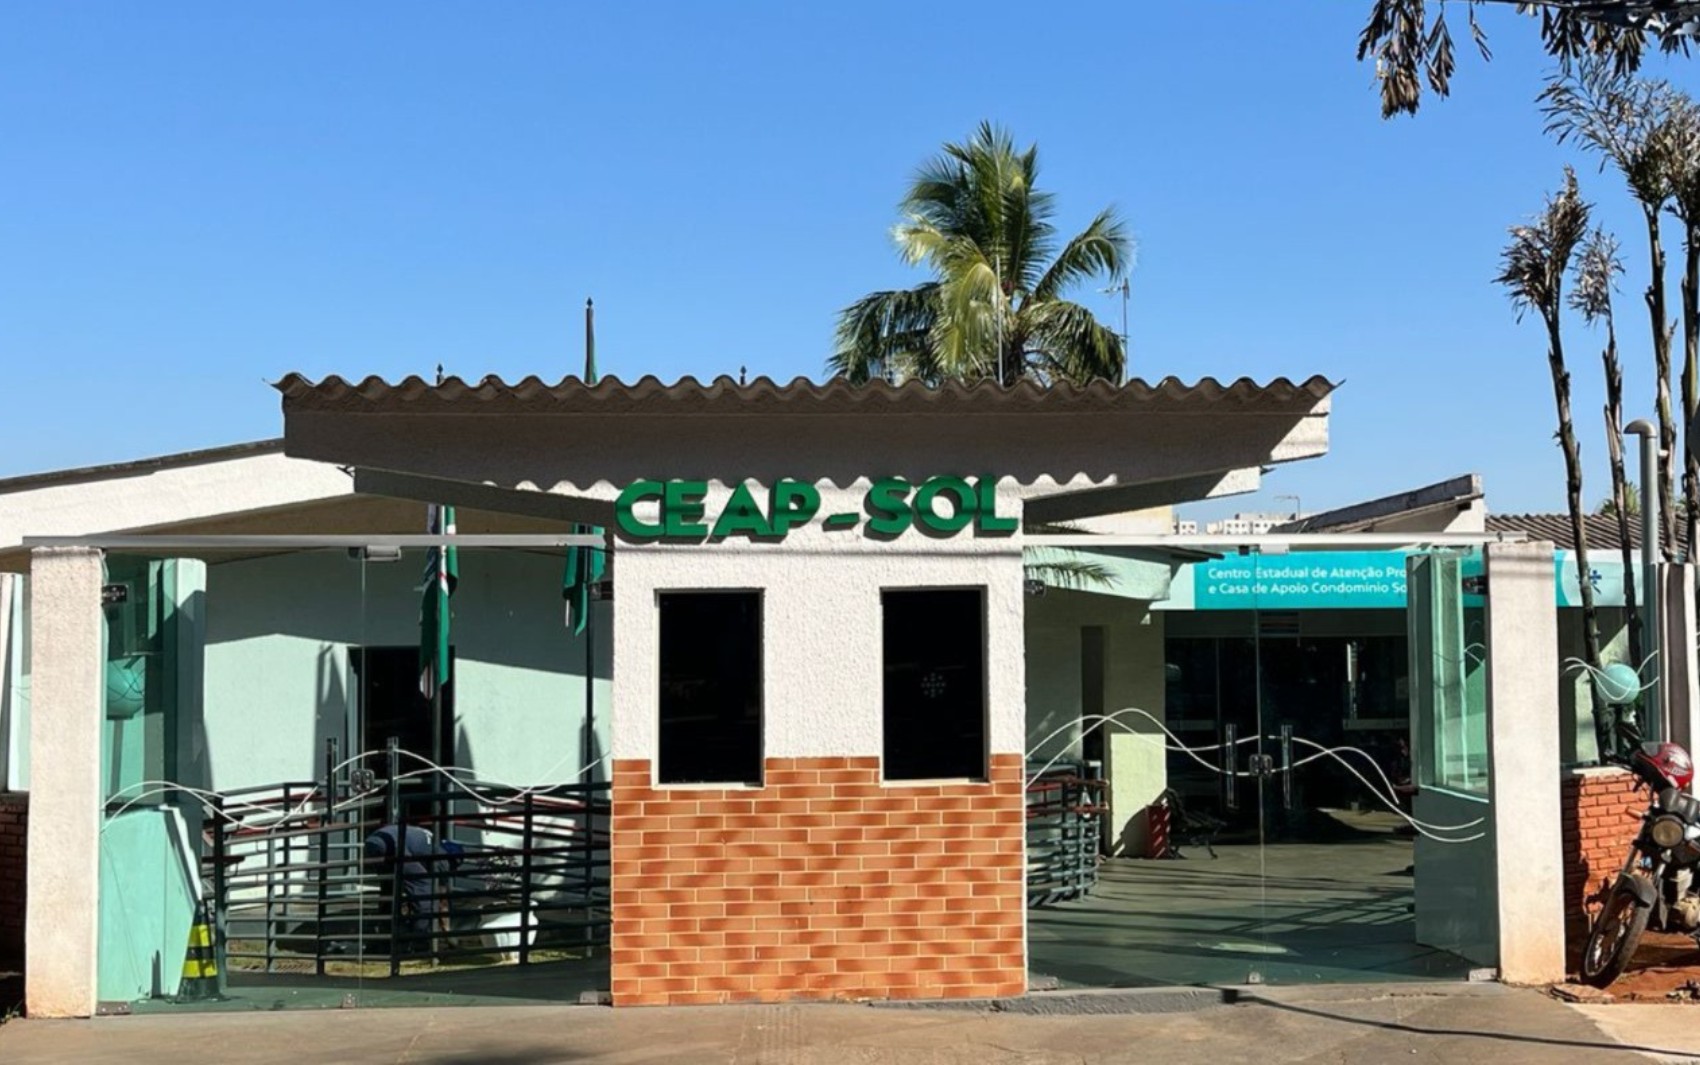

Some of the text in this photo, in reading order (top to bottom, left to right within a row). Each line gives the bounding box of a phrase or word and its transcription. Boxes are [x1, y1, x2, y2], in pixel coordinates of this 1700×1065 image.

[1207, 567, 1252, 579] Centro
[1256, 566, 1309, 579] Estadual
[1311, 566, 1327, 578] de
[1330, 566, 1383, 580] Atenção
[1208, 585, 1217, 594] e
[1219, 582, 1249, 594] Casa
[1251, 582, 1268, 594] de
[1270, 582, 1309, 596] Apoio
